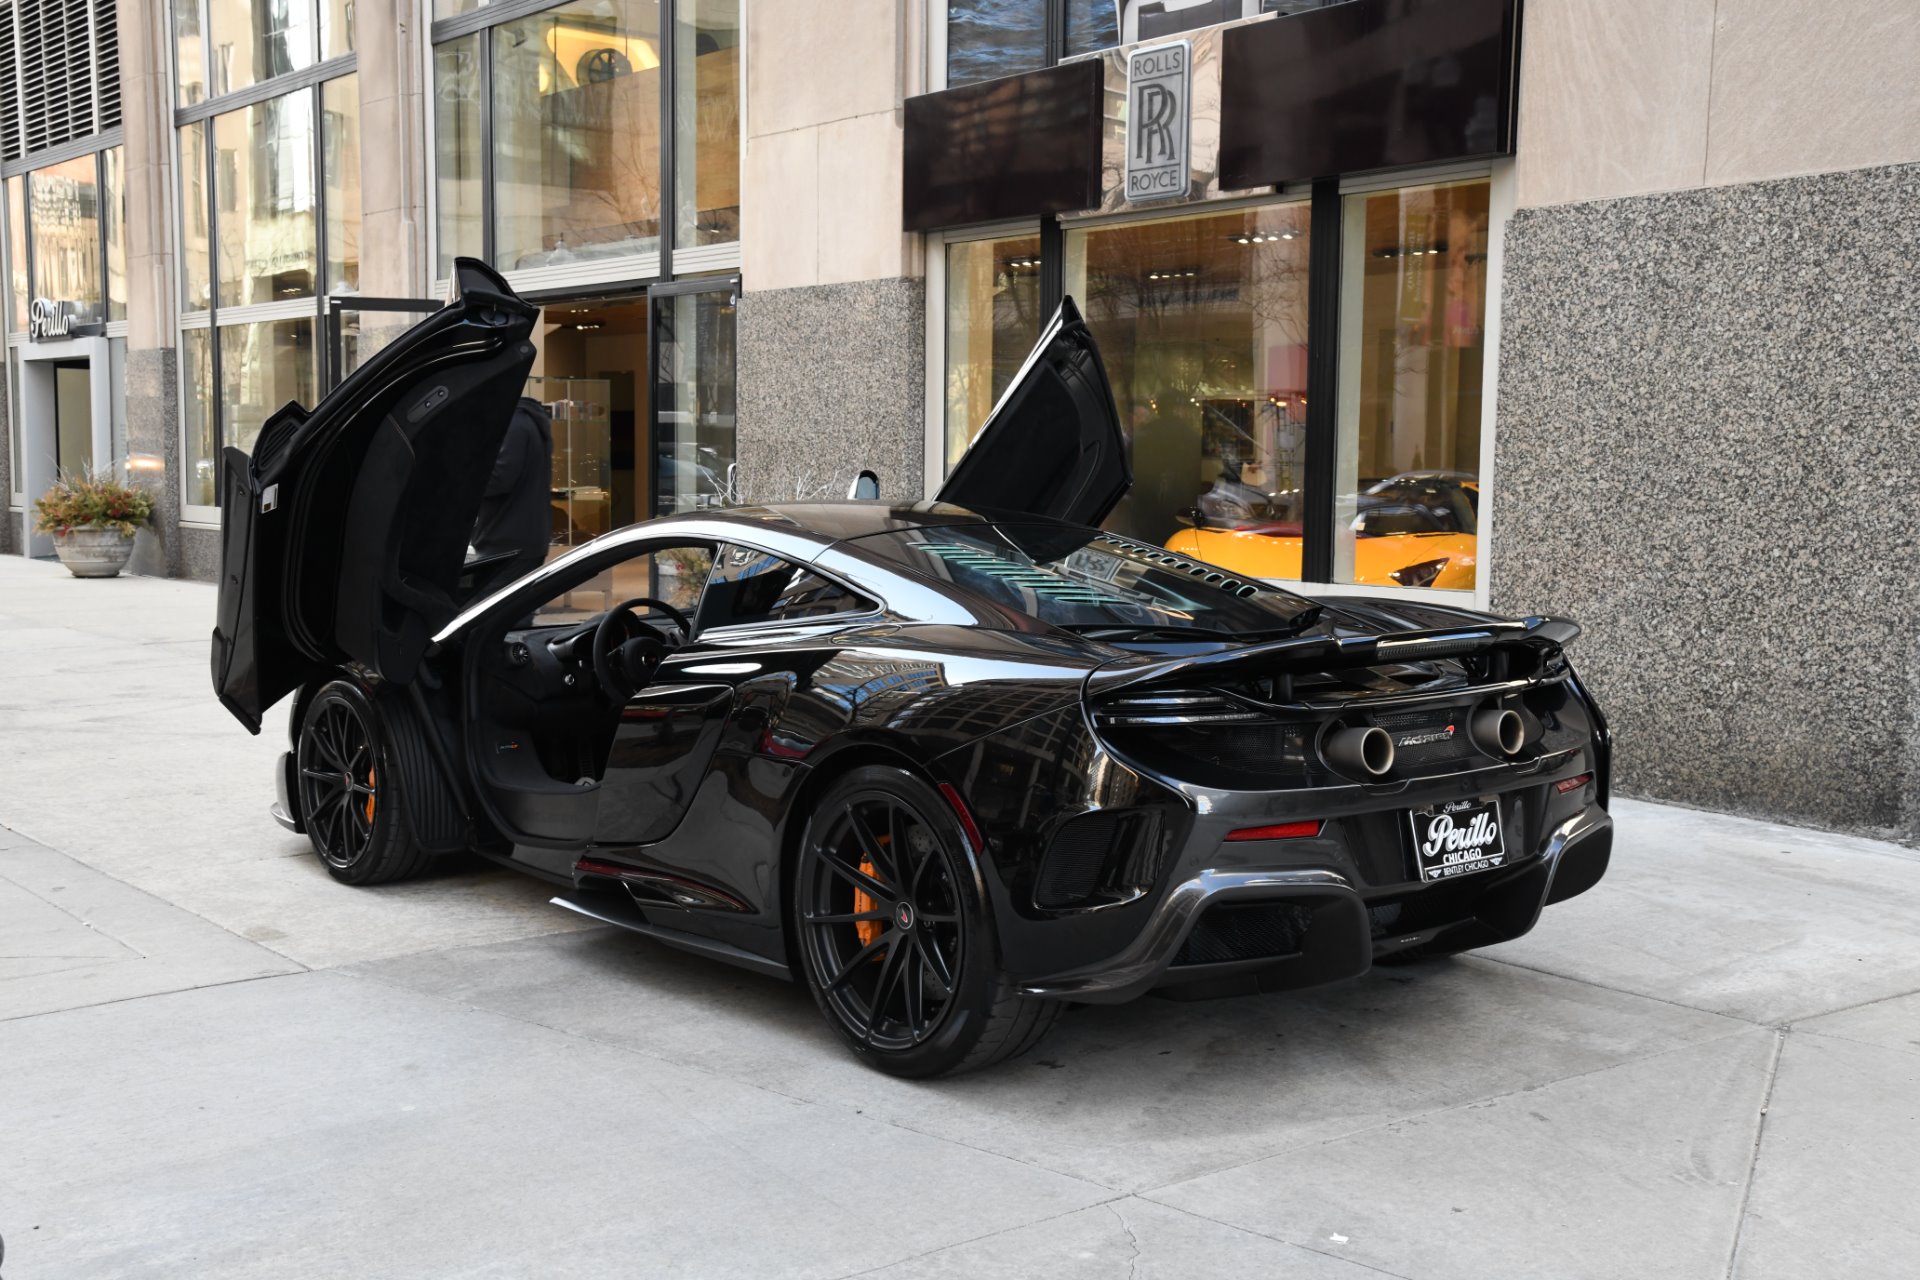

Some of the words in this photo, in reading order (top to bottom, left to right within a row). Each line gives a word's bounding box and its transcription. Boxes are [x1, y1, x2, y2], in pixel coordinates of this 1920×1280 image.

[1133, 51, 1181, 77] ROLLS
[1131, 169, 1178, 192] ROYCE
[31, 297, 69, 338] Perillo
[1443, 800, 1472, 814] Perillo
[1422, 812, 1497, 857] Perillo
[1443, 848, 1482, 865] CHICAGO
[1443, 864, 1464, 876] BENTLEY
[1464, 859, 1489, 872] CHICAGO
